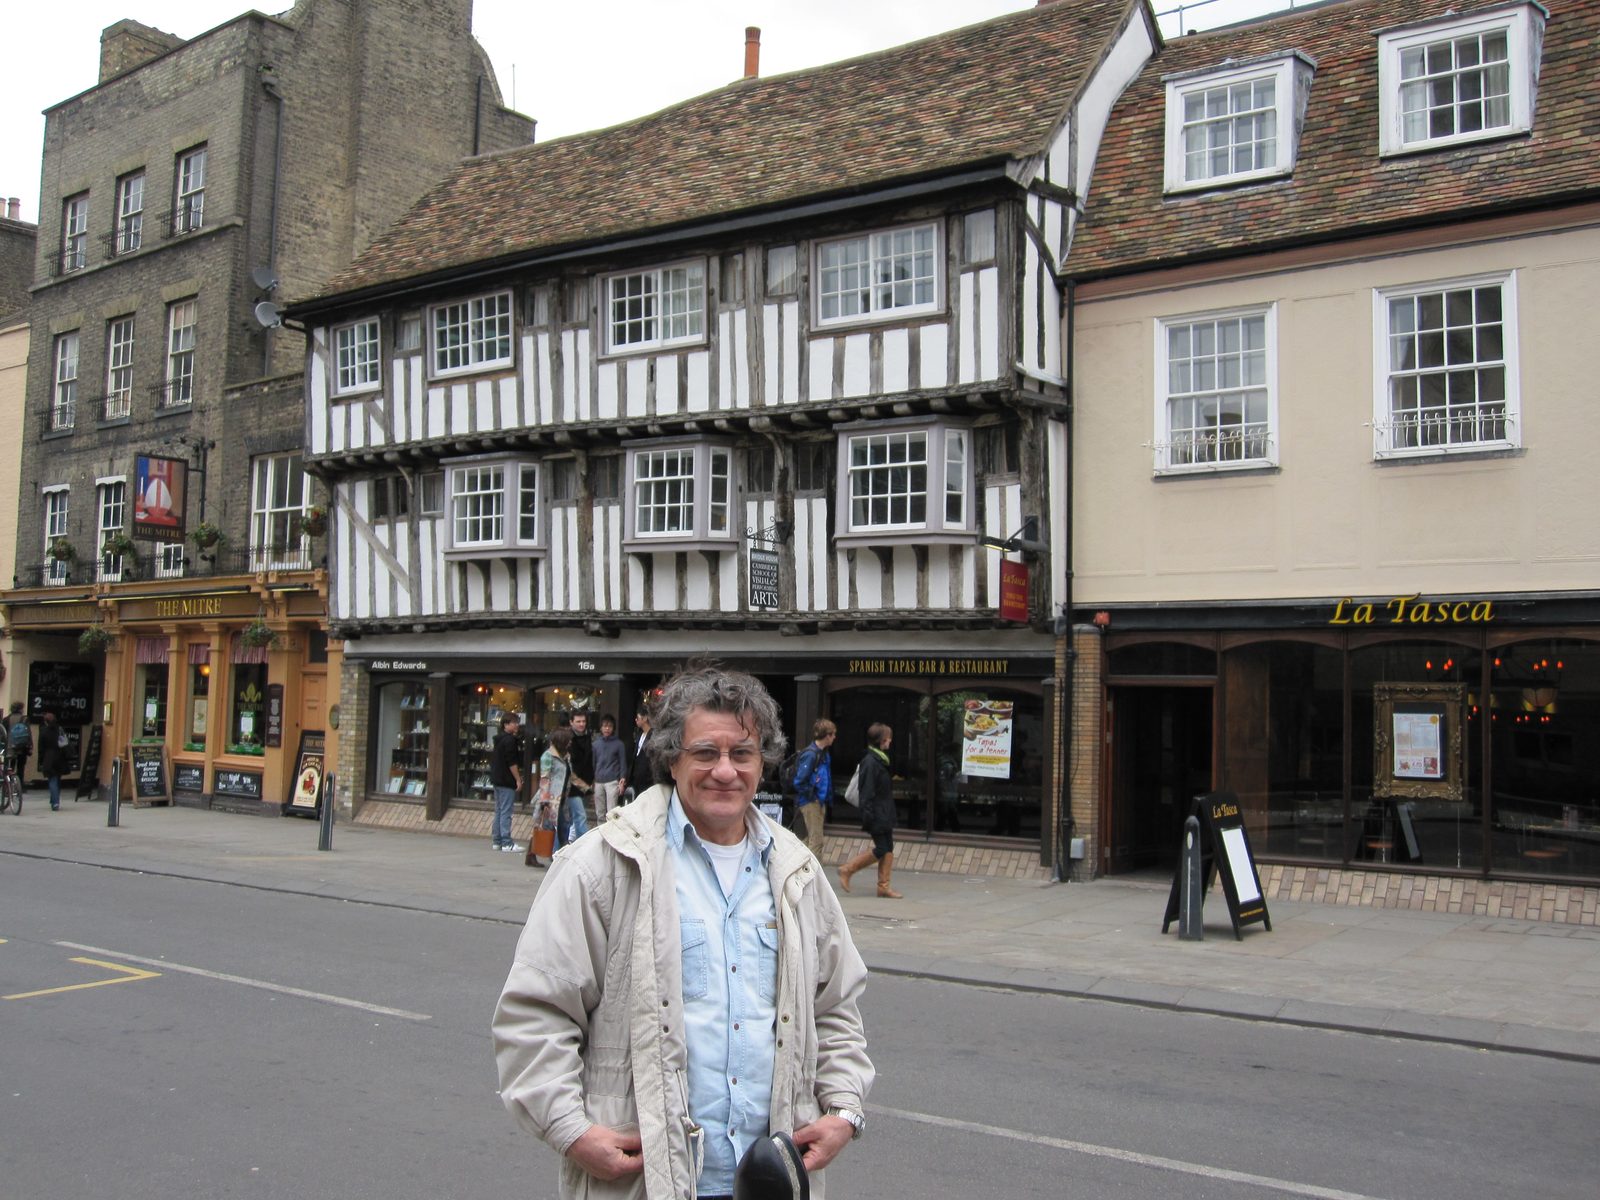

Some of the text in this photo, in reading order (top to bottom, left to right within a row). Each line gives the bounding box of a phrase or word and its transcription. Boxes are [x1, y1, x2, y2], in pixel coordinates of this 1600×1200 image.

[155, 528, 180, 538] MITRE
[752, 590, 778, 606] ARTS
[156, 598, 222, 616] THE MITRE
[1328, 592, 1495, 624] La Tasca
[372, 660, 426, 670] Albin Edwards
[578, 661, 595, 670] 16a
[850, 660, 1008, 673] SPANISH TAPAS BAR & RESTAURANT
[978, 738, 998, 748] Tapas
[966, 744, 976, 754] for
[987, 746, 1008, 754] tenner
[1212, 804, 1238, 818] La Tasca
